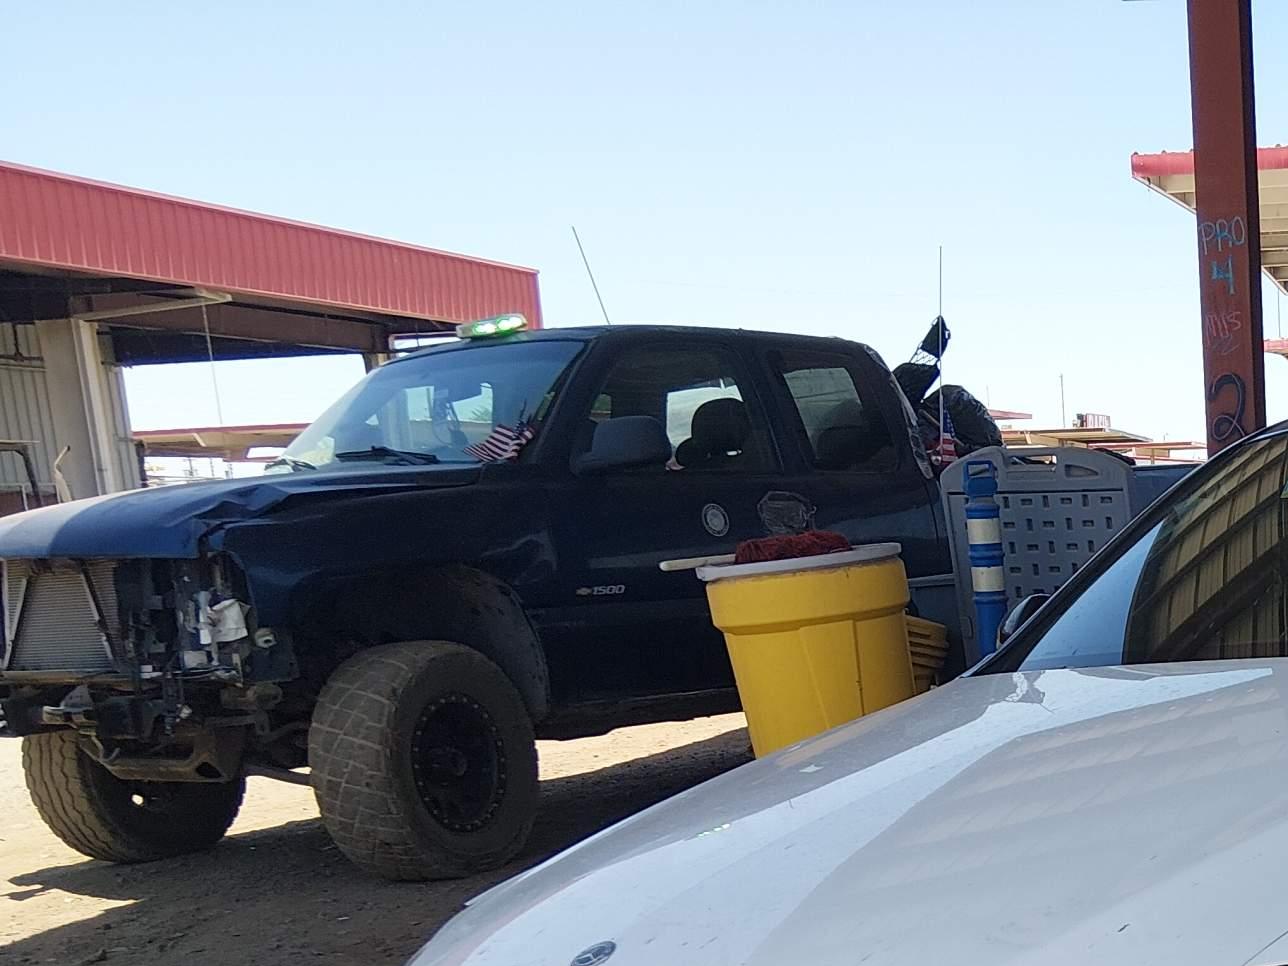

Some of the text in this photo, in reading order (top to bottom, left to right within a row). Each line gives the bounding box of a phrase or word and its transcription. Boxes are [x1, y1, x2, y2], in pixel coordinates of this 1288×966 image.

[1200, 216, 1245, 255] PRO
[1211, 256, 1235, 295] 4
[1208, 373, 1246, 440] 2
[592, 585, 626, 595] 1500
